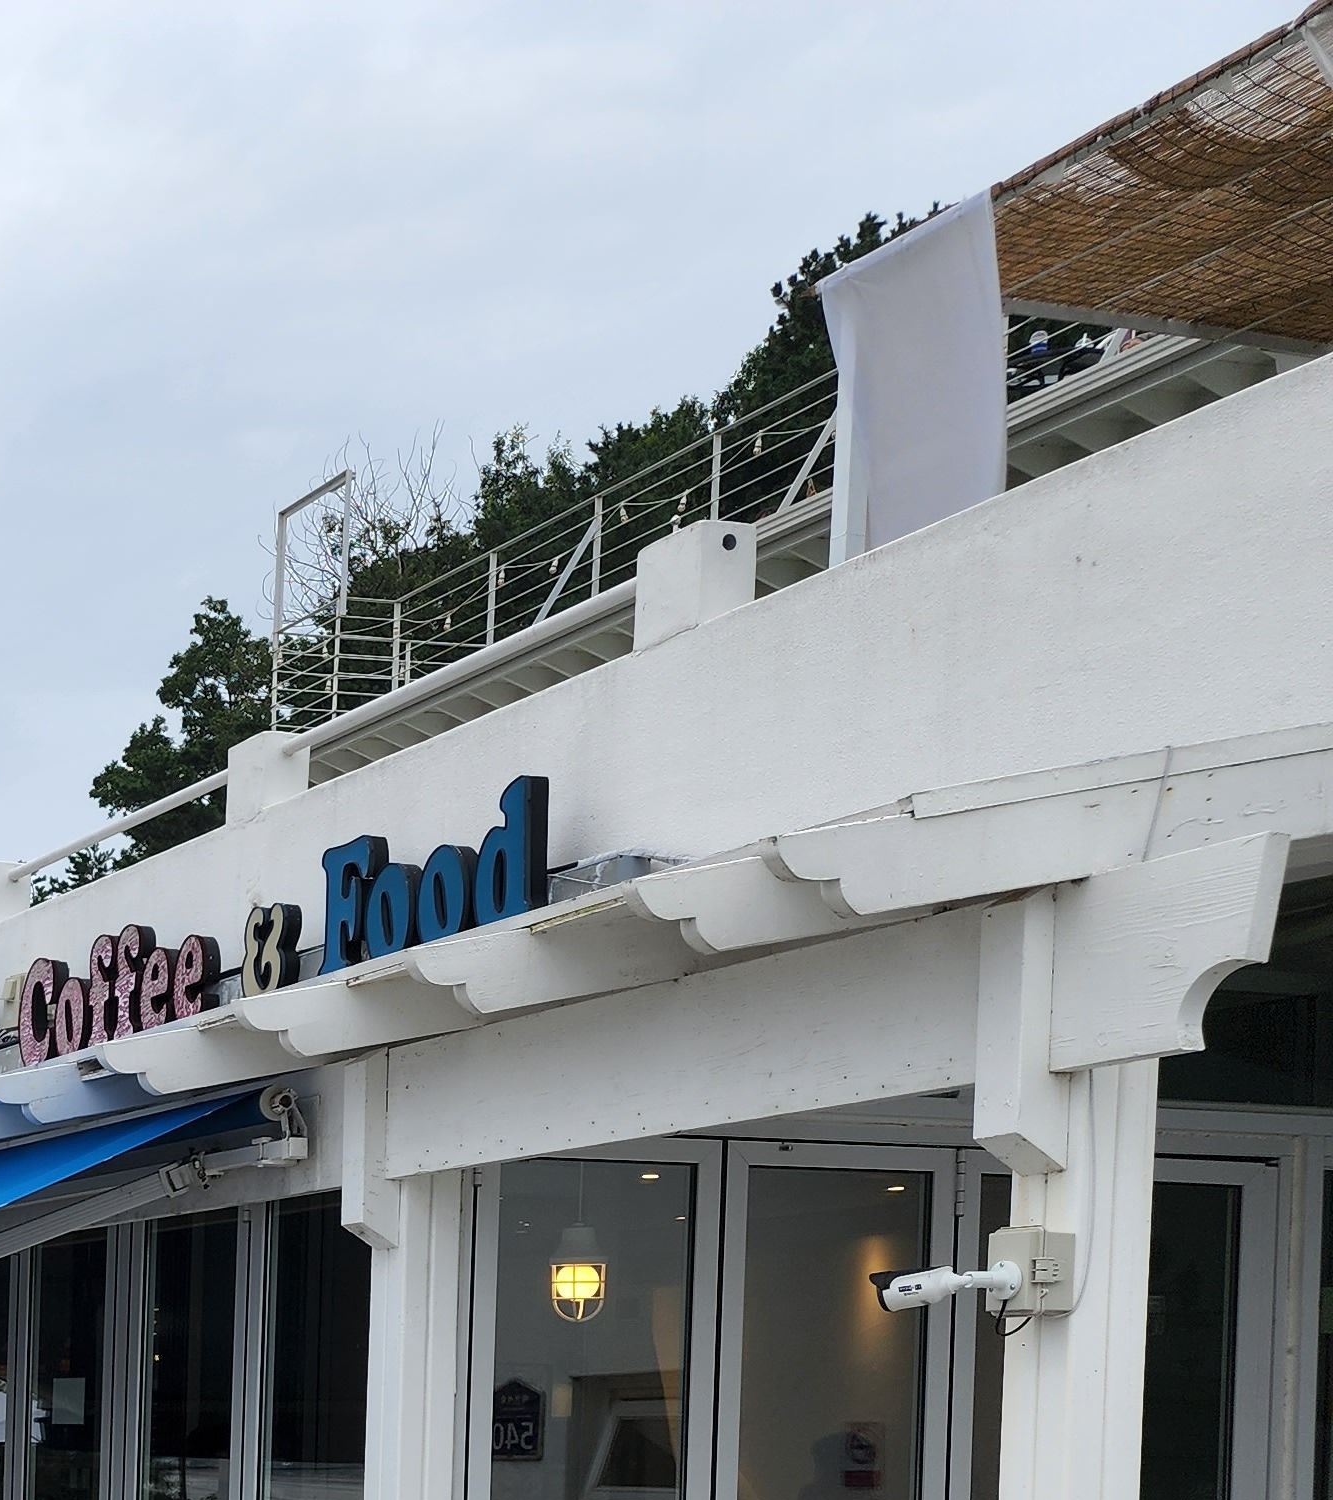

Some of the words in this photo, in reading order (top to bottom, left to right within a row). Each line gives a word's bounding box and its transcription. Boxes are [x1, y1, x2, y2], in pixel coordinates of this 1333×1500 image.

[19, 925, 221, 1066] Coffee
[241, 903, 302, 998] &
[319, 775, 549, 976] Food
